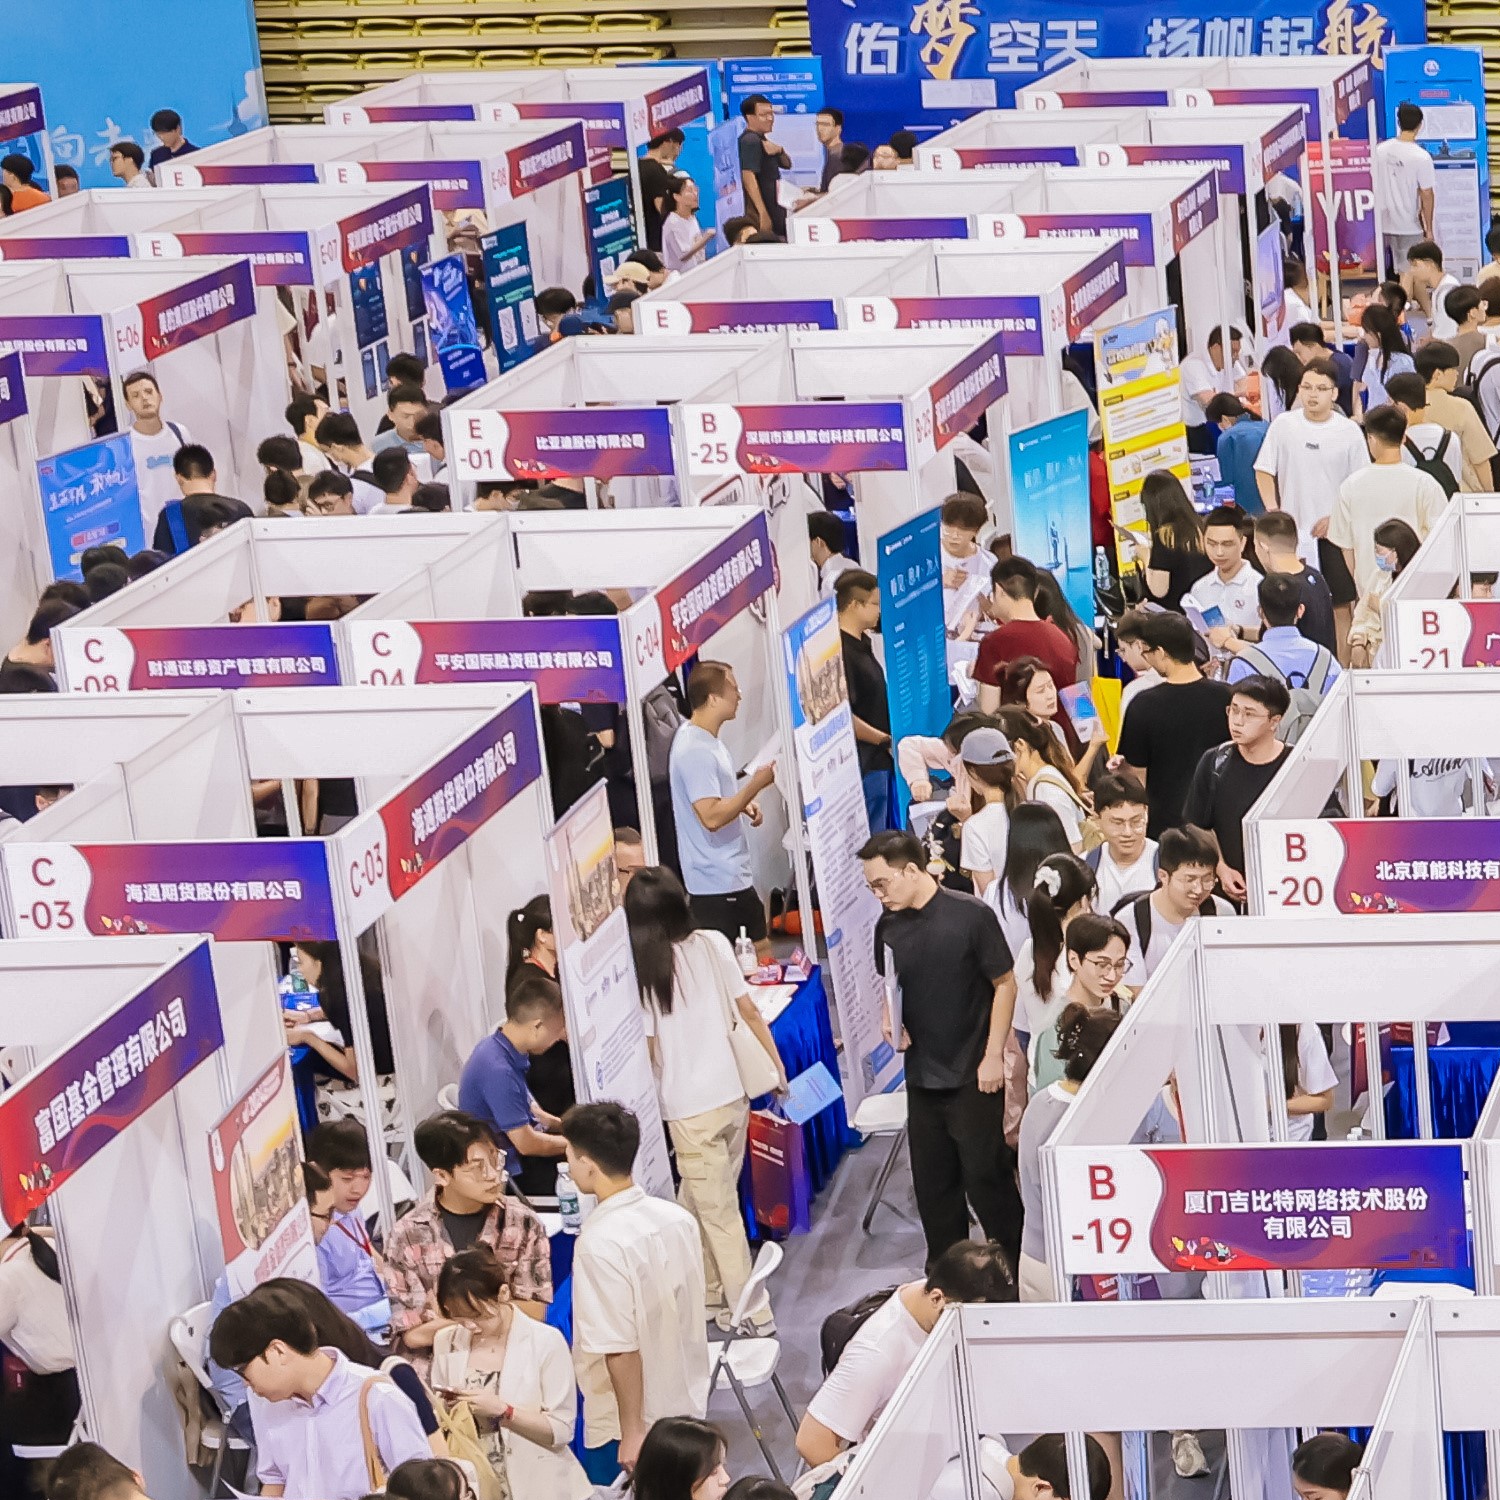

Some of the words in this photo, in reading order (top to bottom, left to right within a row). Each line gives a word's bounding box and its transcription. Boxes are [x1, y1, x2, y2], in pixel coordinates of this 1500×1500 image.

[1317, 191, 1373, 222] VIP
[809, 226, 819, 243] E
[994, 221, 1004, 238] B
[152, 240, 162, 257] E
[656, 310, 669, 328] E
[862, 304, 873, 322] B
[469, 417, 483, 440] E
[702, 413, 716, 433] B
[459, 452, 494, 470] -01
[691, 444, 728, 463] -25
[1422, 611, 1440, 635] B
[84, 638, 103, 663] C
[371, 632, 392, 658] C
[634, 627, 660, 671] C-04
[149, 657, 326, 677] 财通证券资产管理有限公司
[435, 650, 612, 670] 平安国际融资租赁有限公司
[1409, 647, 1450, 669] -21
[410, 730, 517, 846] 海通期货股份有限公司
[1285, 833, 1307, 862] B
[31, 857, 56, 886] C
[349, 842, 385, 898] C-03
[125, 880, 302, 903] 海通期货股份有限公司
[1268, 877, 1323, 906] -20
[18, 901, 75, 930] -03
[34, 997, 188, 1154] 富国基金管理有限公司
[1090, 1165, 1116, 1199] B
[1183, 1187, 1428, 1214] 厦门吉比特网络技术股份
[1072, 1219, 1133, 1254] -19
[1263, 1215, 1352, 1240] 有限公司
